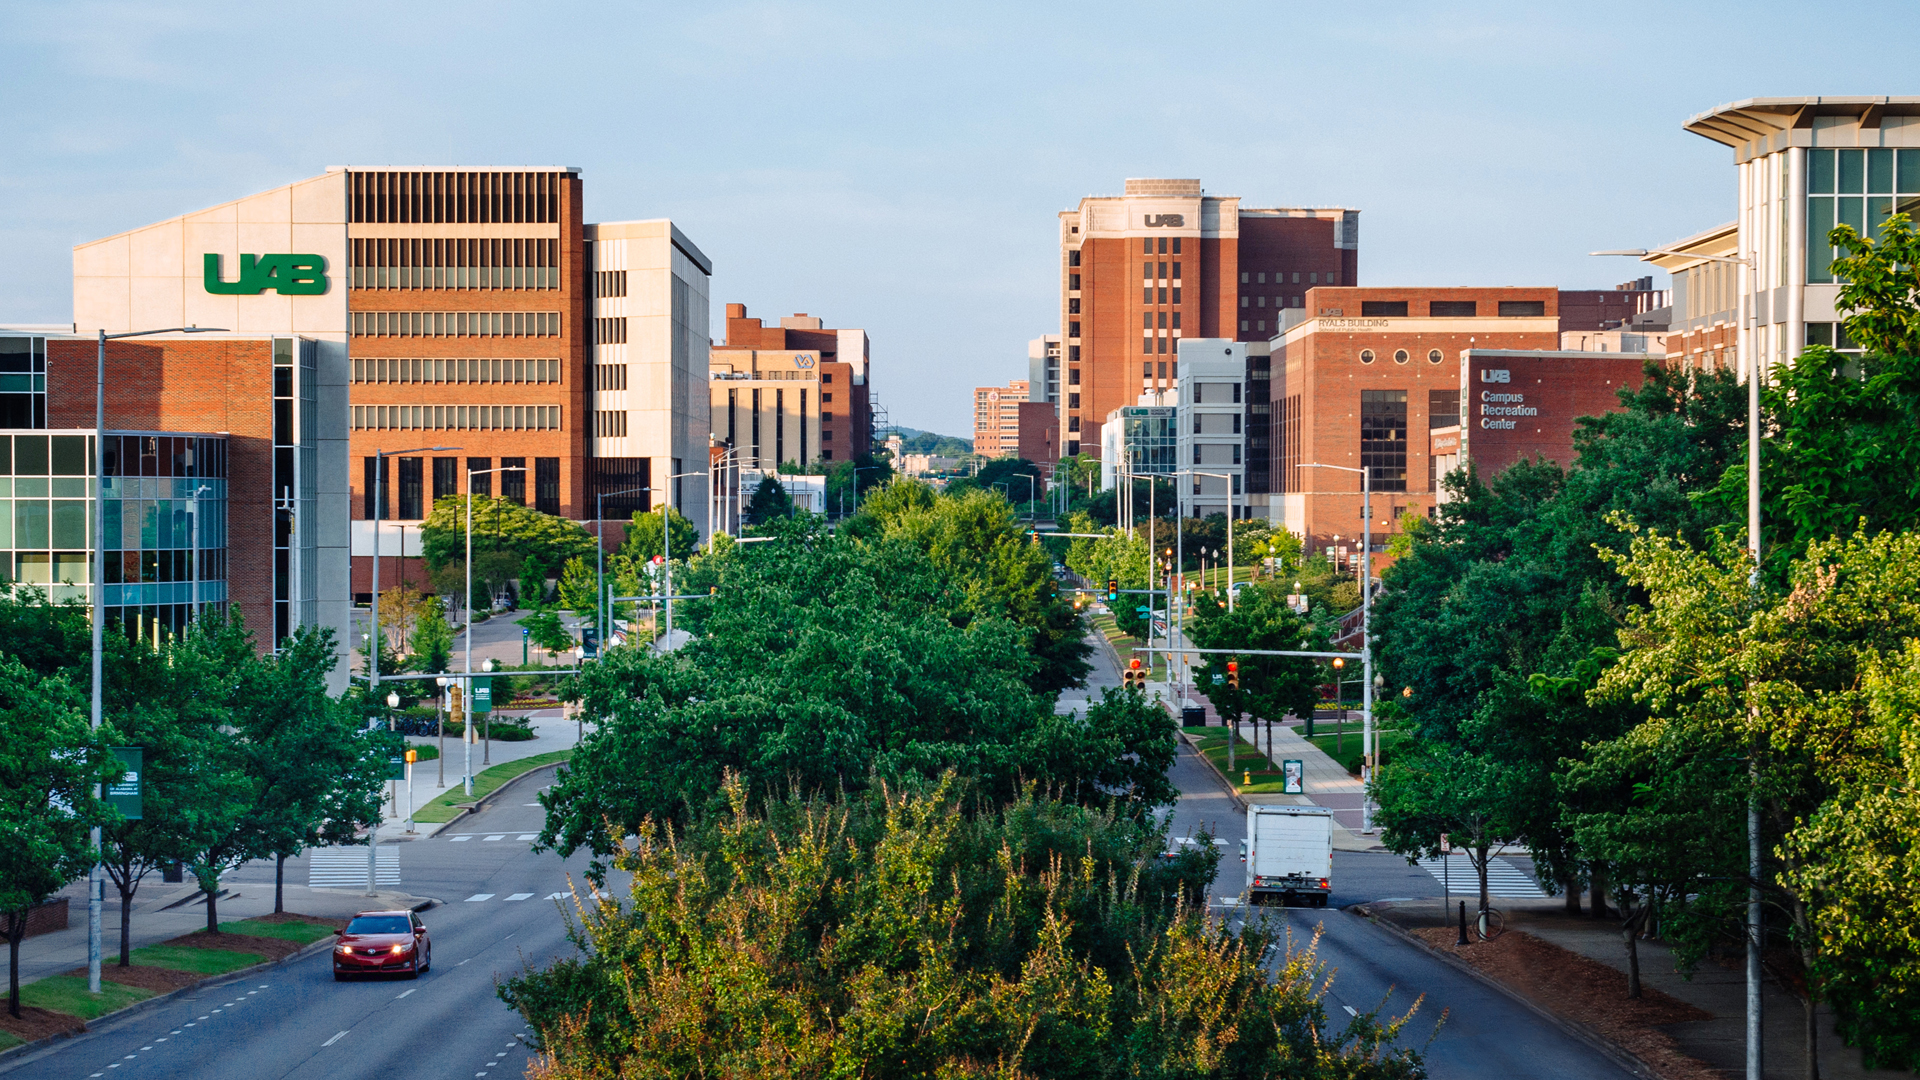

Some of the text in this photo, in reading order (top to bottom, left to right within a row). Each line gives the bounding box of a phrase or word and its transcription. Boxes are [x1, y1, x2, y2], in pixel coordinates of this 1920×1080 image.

[1144, 214, 1183, 228] UAB
[204, 253, 327, 295] UAB
[1319, 308, 1343, 317] UAB
[1318, 319, 1389, 327] RYALS BUILDING
[1481, 369, 1511, 383] UAB
[1481, 390, 1524, 404] Campus
[1481, 404, 1537, 416] Recreation
[1481, 418, 1517, 430] Center
